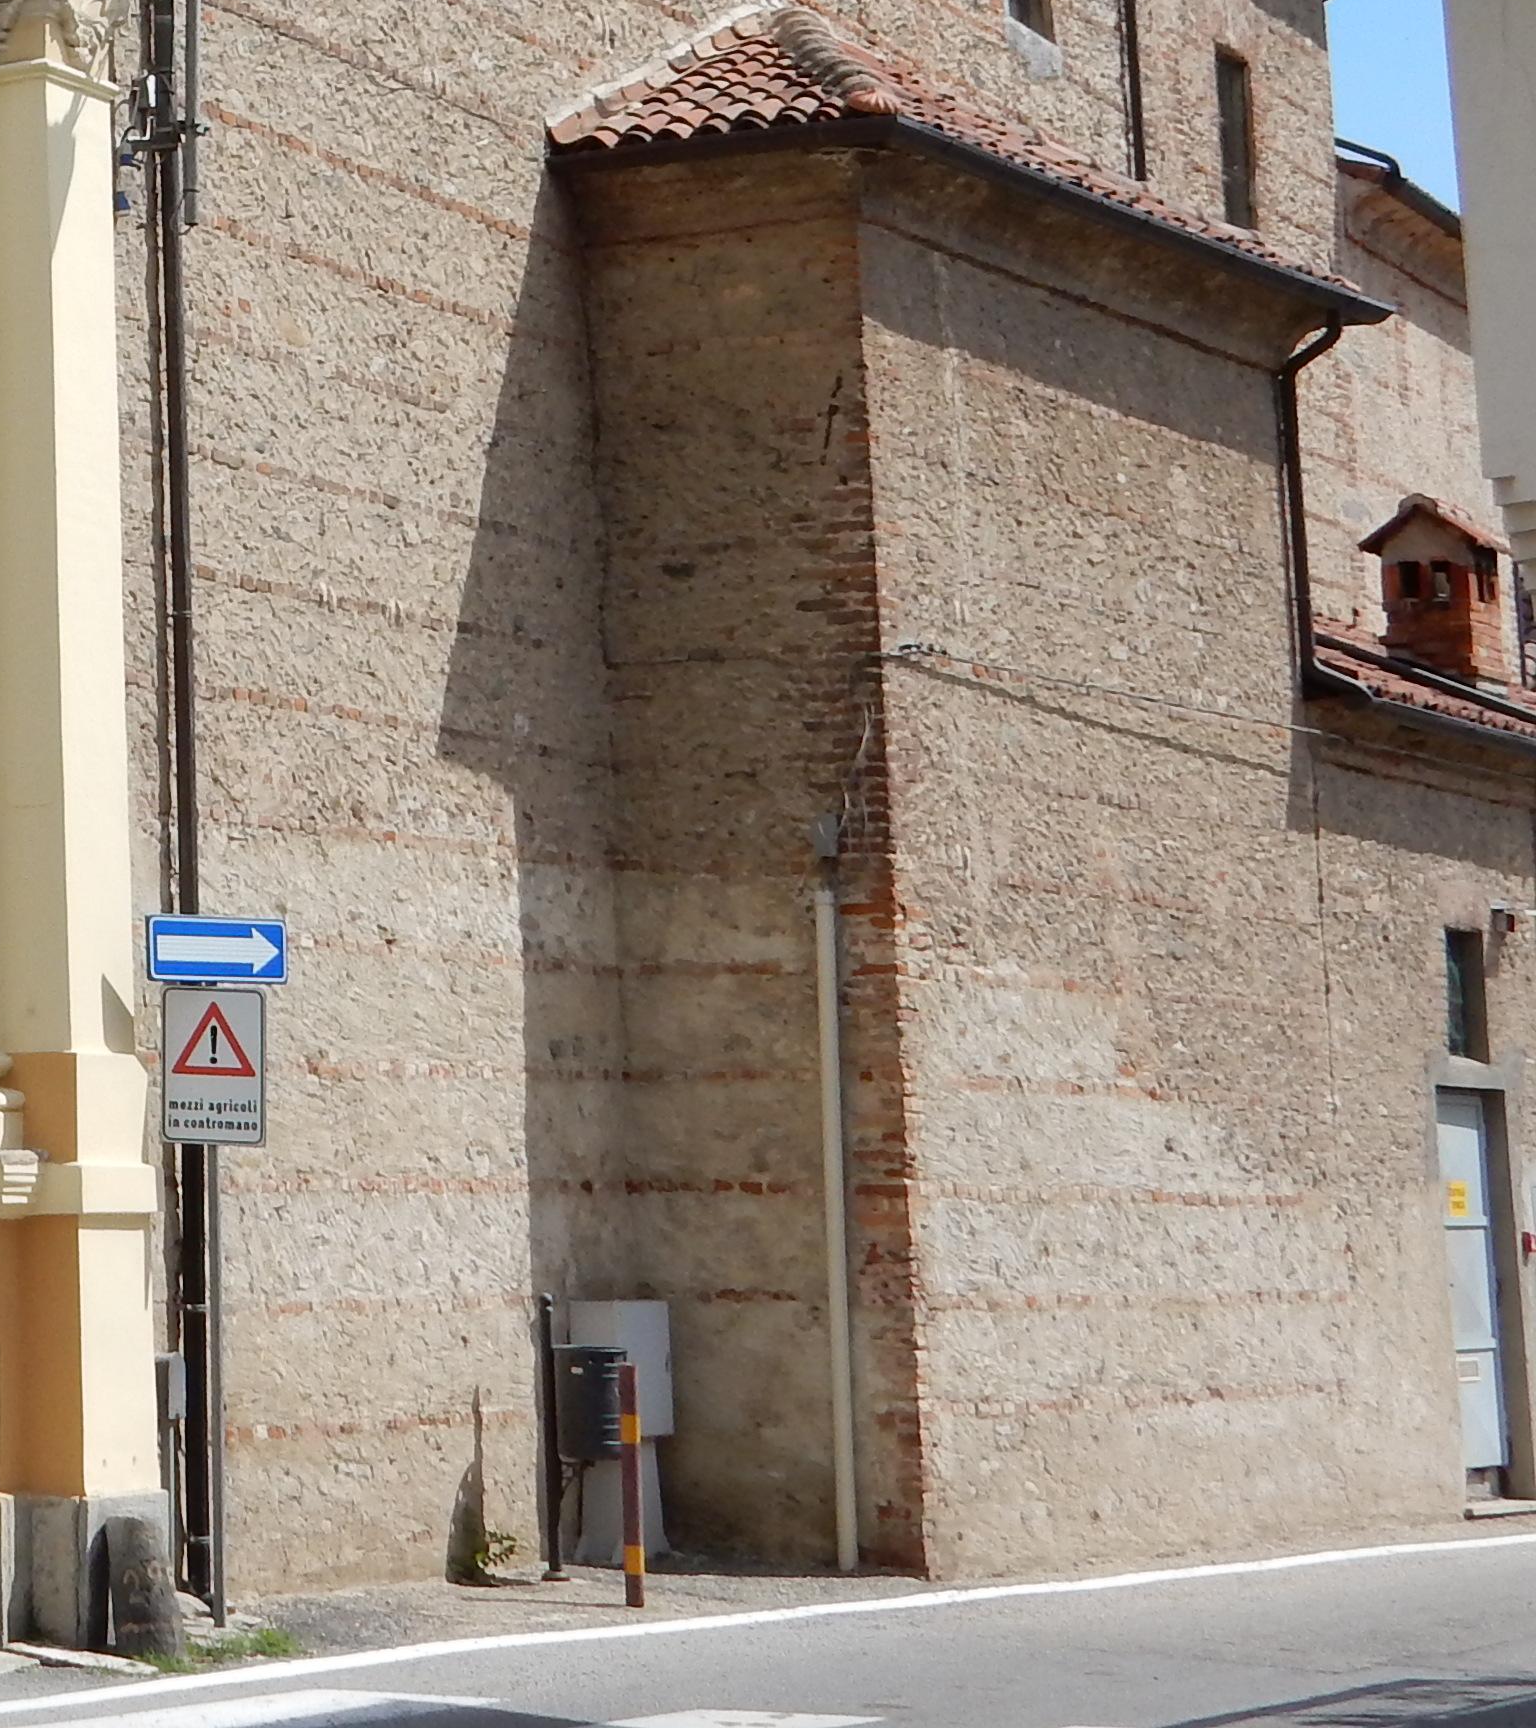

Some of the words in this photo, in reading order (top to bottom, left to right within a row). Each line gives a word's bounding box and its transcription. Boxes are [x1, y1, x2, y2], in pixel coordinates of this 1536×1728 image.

[169, 1098, 204, 1111] mezzi
[208, 1099, 258, 1115] agricoli
[168, 1114, 180, 1128] in
[183, 1117, 258, 1131] contromano
